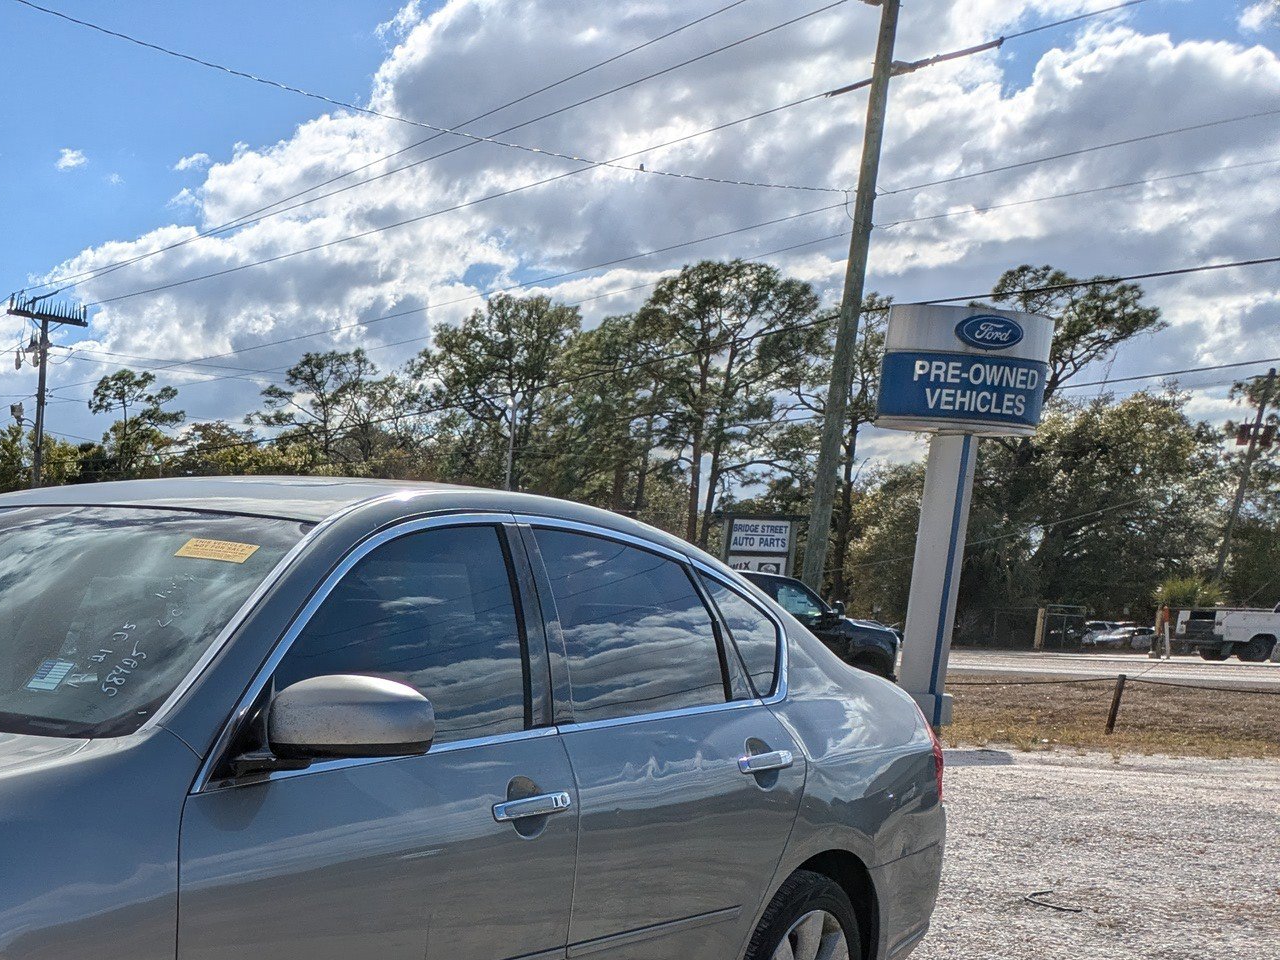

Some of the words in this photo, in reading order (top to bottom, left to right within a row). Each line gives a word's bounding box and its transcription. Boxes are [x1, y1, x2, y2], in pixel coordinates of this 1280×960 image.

[974, 322, 1012, 342] Ford
[913, 360, 1039, 390] PRE-OWNED
[925, 387, 1026, 416] VEHICLES
[733, 523, 760, 533] BRIDGE
[761, 524, 789, 534] STREET
[732, 536, 755, 547] AUTO
[759, 537, 787, 548] PARTS
